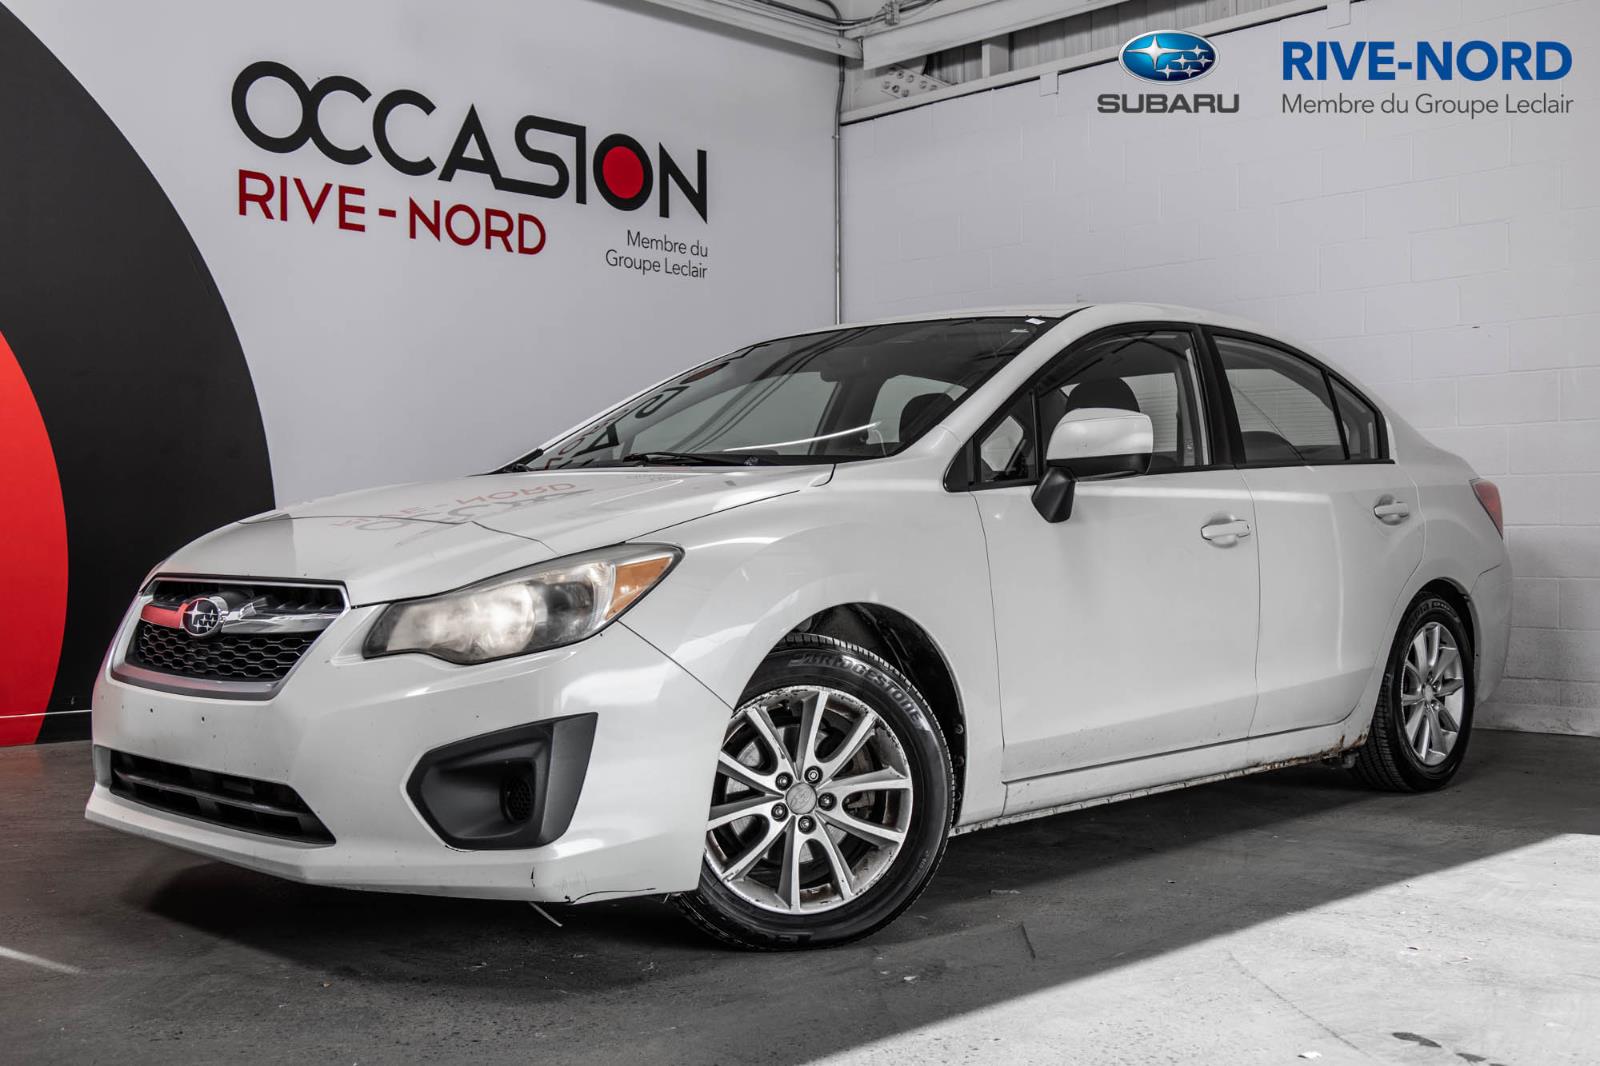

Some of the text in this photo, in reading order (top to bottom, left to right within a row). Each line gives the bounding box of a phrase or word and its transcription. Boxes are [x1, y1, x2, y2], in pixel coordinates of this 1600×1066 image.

[232, 61, 708, 225] OCCASION
[626, 229, 708, 258] Membre du
[605, 248, 708, 279] Groupe Leclair
